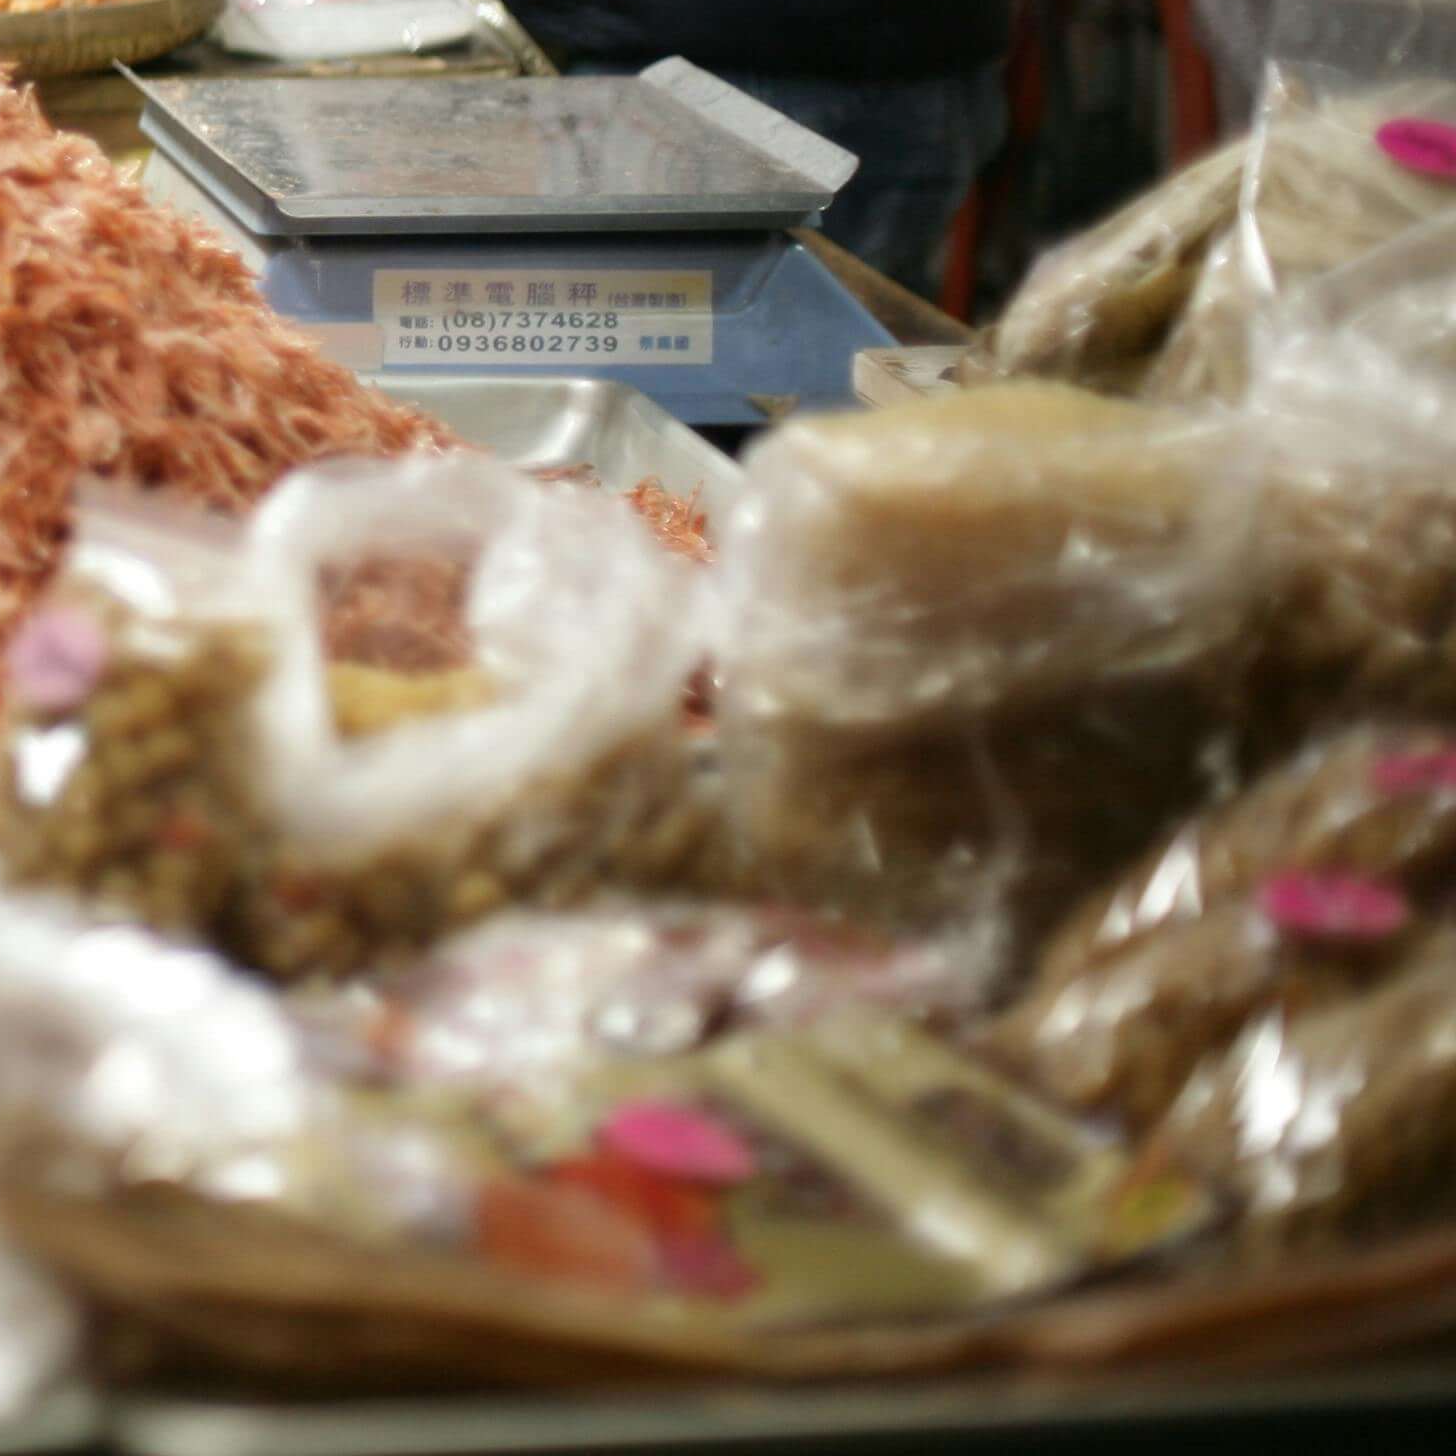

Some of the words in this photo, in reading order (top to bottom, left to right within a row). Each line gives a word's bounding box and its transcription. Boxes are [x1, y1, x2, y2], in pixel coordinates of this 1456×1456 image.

[400, 280, 599, 308] 標準電腦秤
[442, 310, 620, 332] (08)7374628
[438, 334, 620, 352] 0936802739
